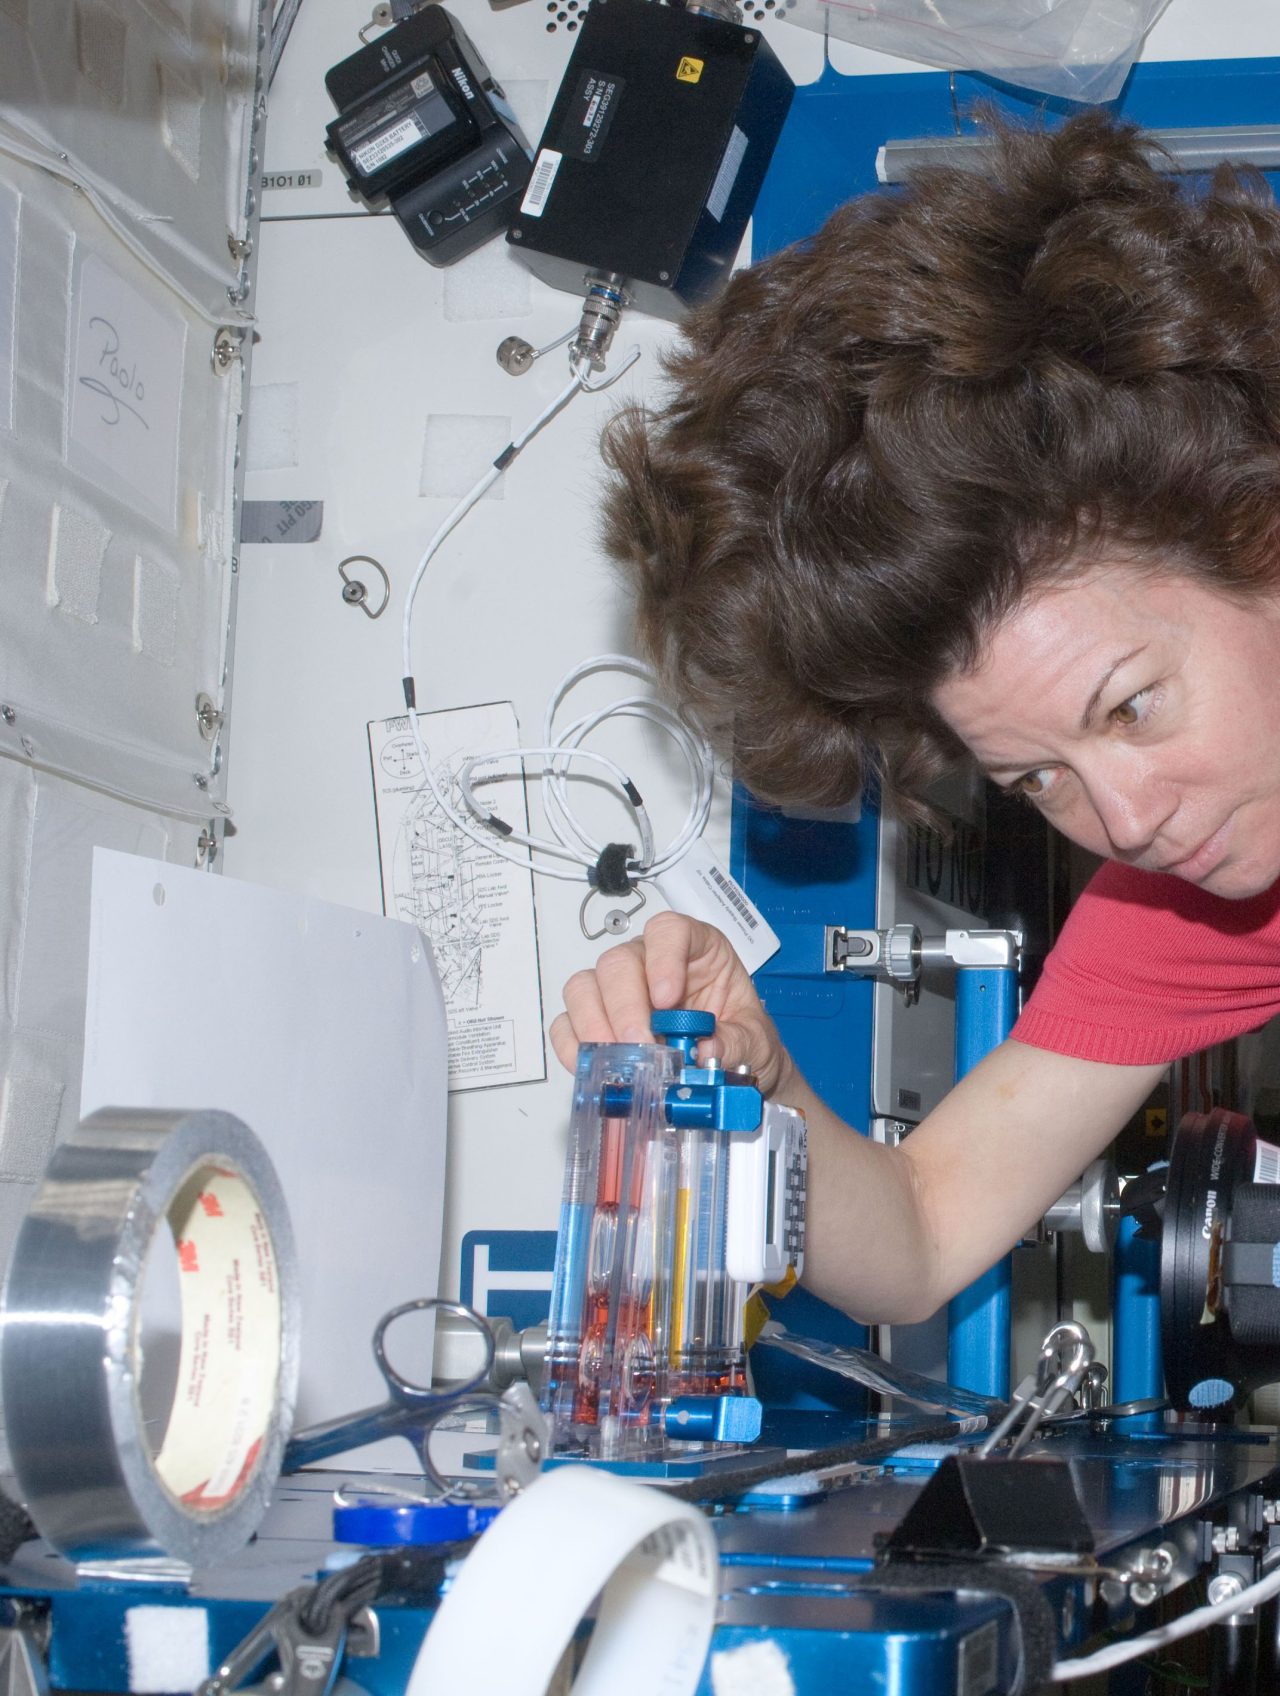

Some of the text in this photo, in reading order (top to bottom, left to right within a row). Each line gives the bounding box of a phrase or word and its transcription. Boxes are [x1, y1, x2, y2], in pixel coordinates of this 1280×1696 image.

[451, 67, 475, 100] Nikon
[583, 78, 596, 102] ASSY
[389, 122, 414, 140] BATTERY
[200, 1192, 224, 1218] 3M
[1202, 1190, 1218, 1240] Canon
[178, 1240, 200, 1272] 3M
